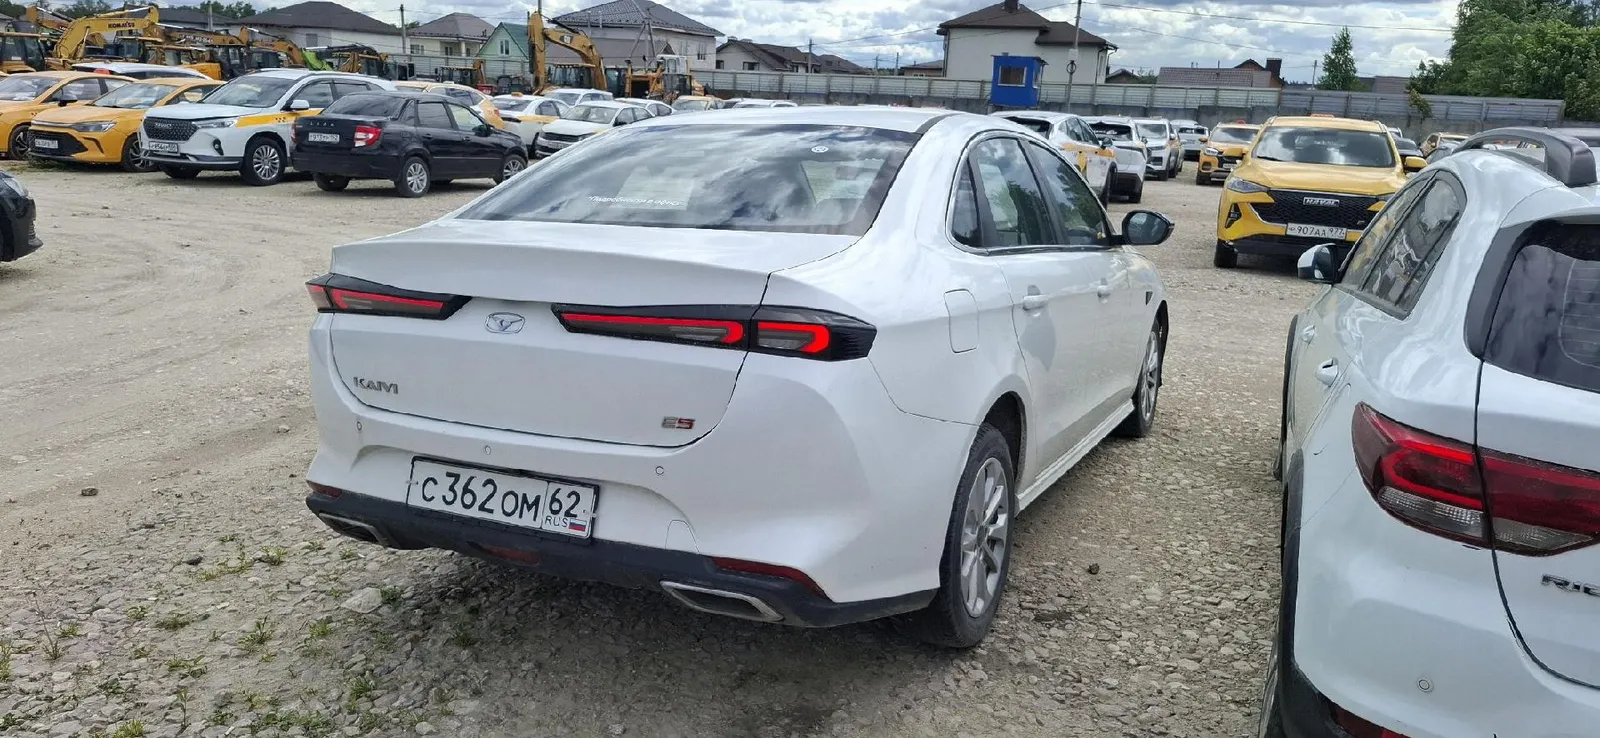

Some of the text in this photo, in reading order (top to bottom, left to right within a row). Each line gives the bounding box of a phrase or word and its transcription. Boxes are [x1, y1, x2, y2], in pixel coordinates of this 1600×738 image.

[108, 21, 135, 29] KOMATSU
[549, 487, 581, 518] 62
[544, 515, 569, 529] RUS
